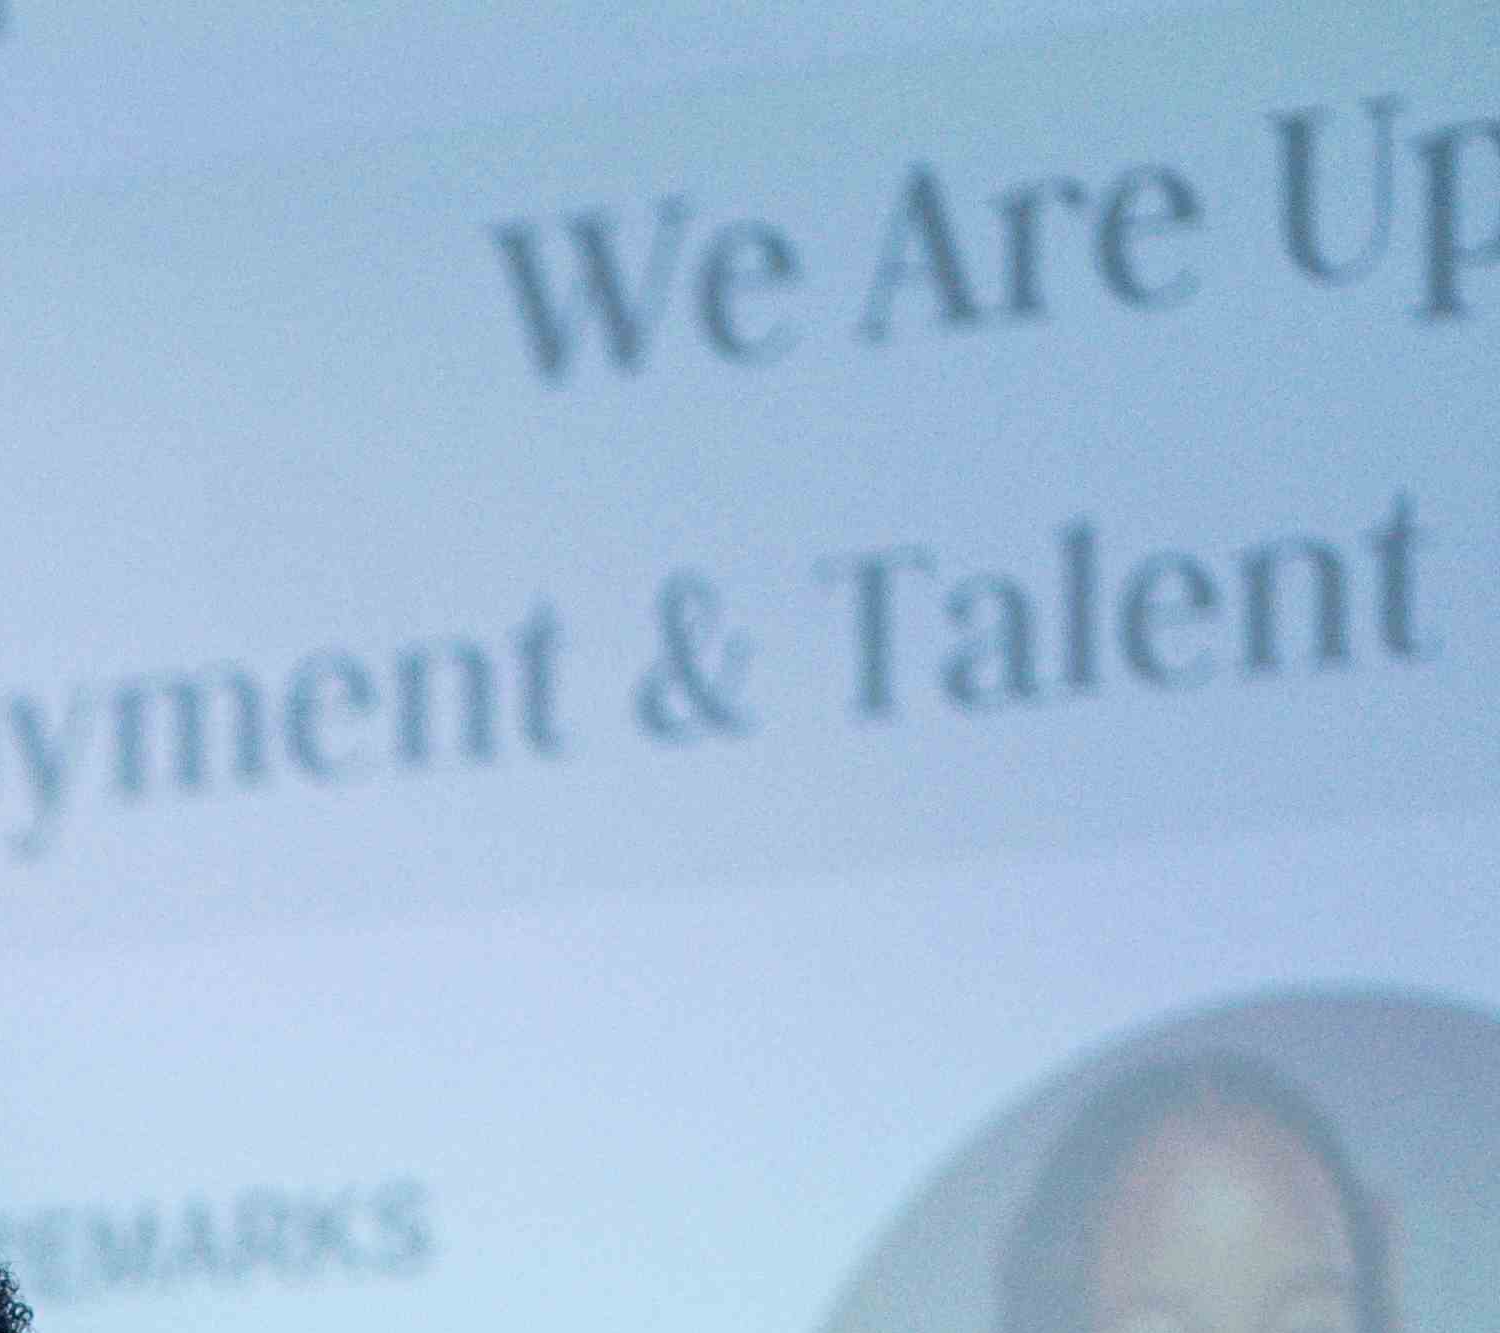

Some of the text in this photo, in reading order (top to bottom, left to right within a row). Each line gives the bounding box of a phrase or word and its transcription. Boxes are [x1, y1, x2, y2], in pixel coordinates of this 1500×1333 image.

[490, 89, 1500, 388] We Are Up
[629, 564, 759, 743] &
[811, 489, 1439, 725] Talent
